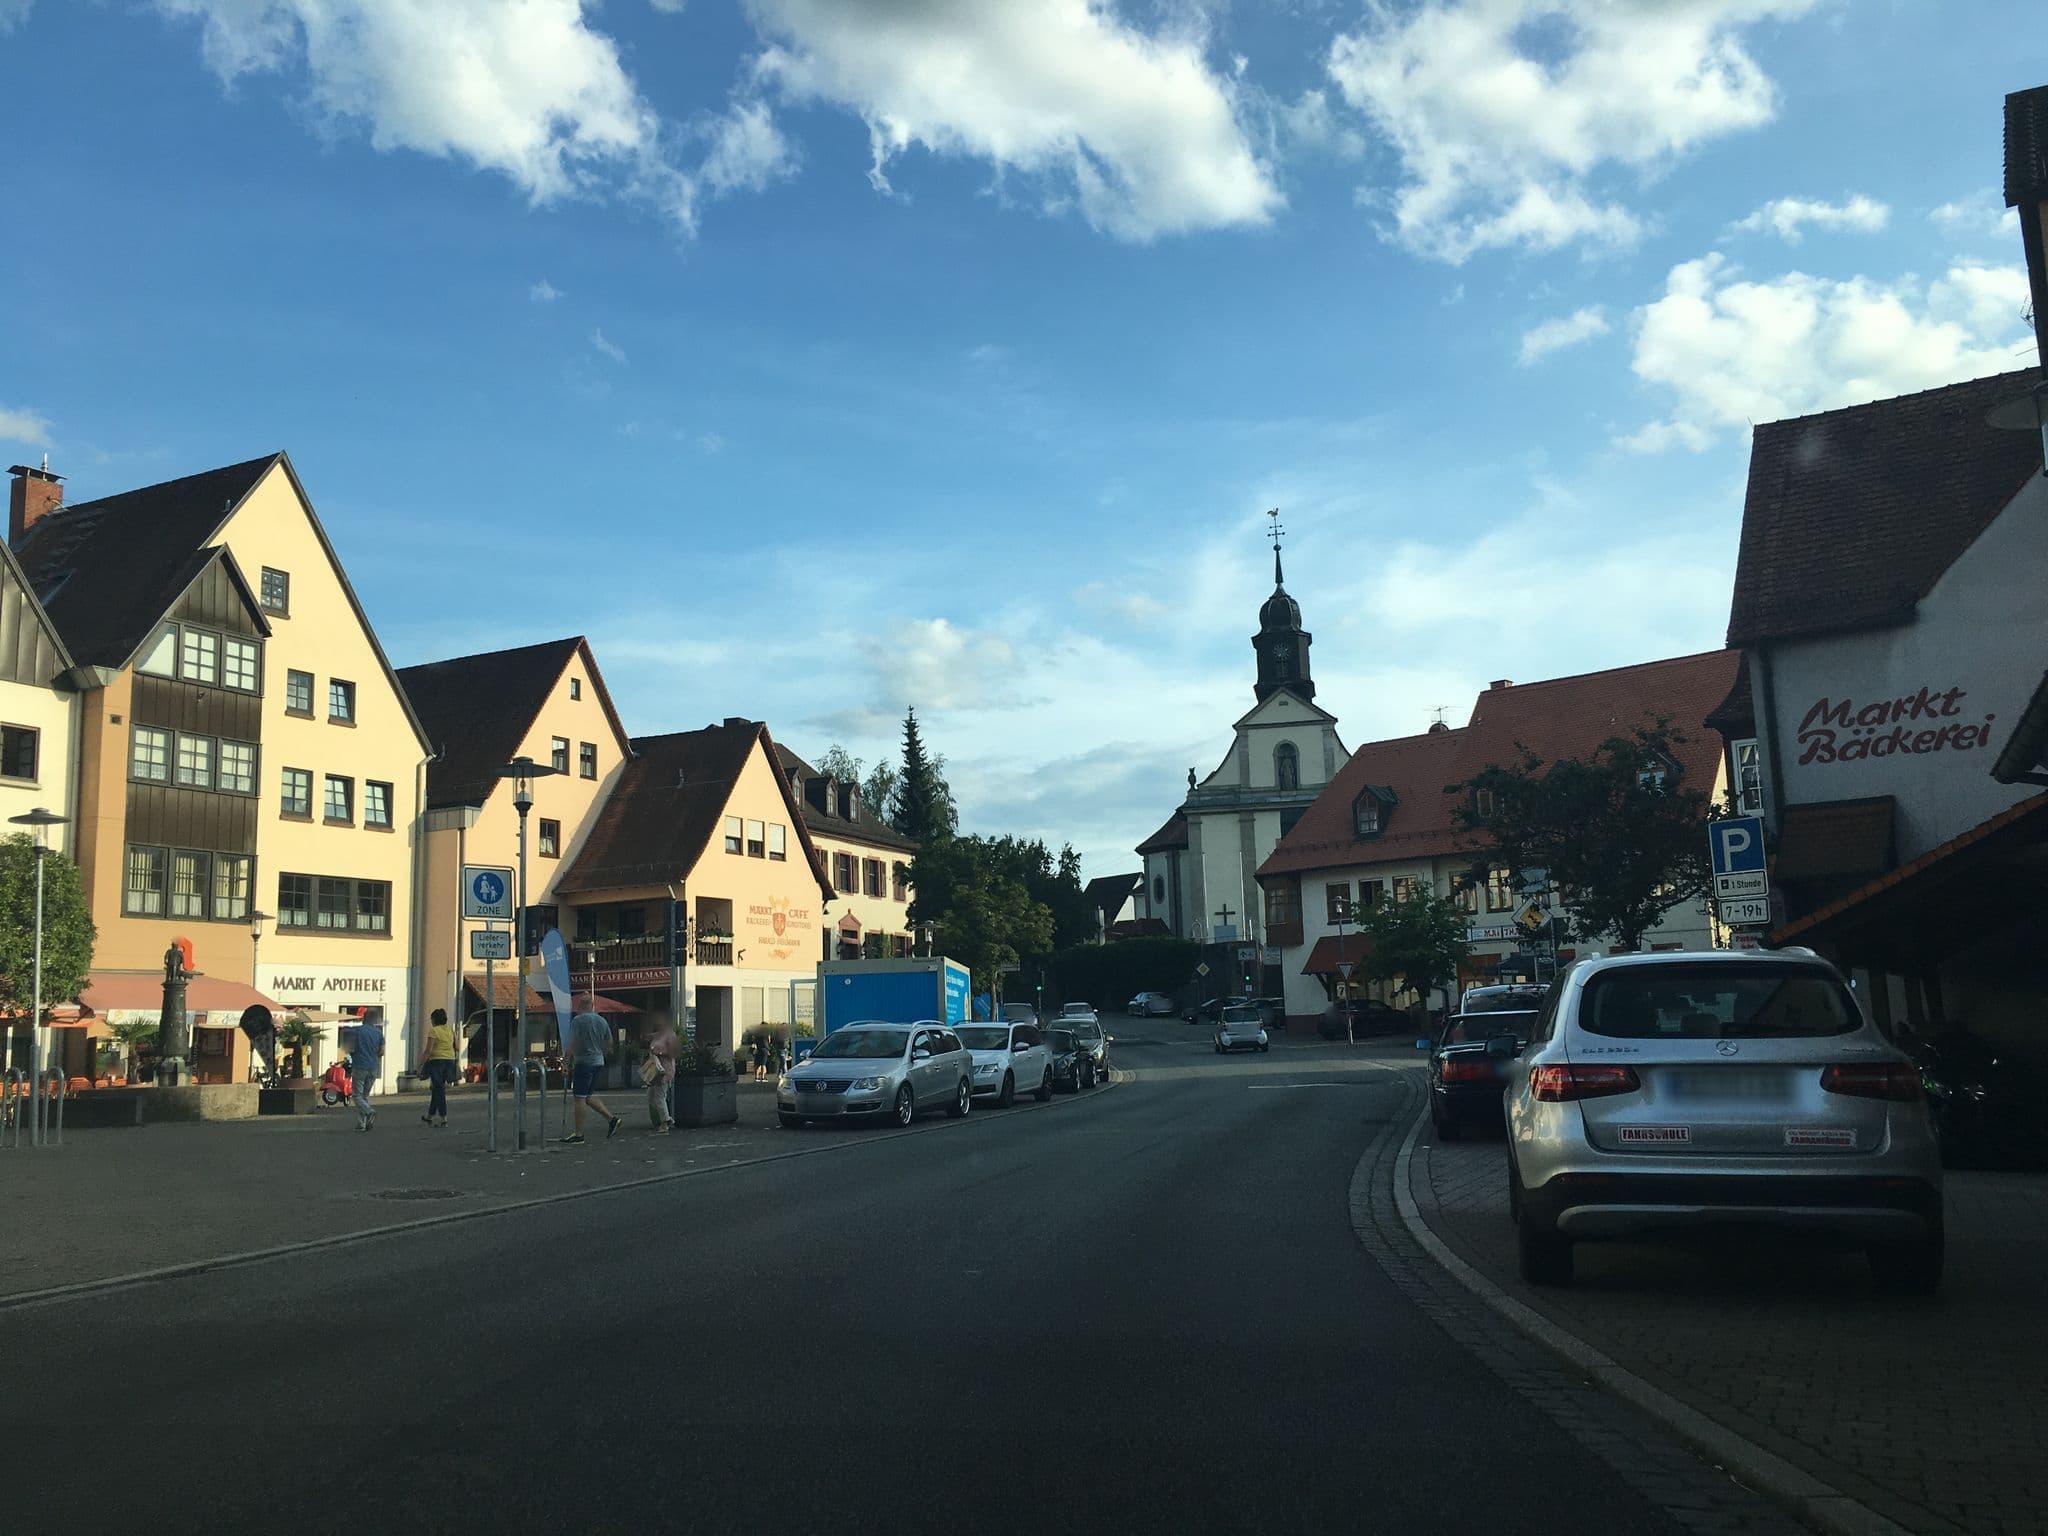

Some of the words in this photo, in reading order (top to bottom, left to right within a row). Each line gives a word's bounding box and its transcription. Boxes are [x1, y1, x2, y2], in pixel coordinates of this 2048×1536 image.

[1797, 686, 1967, 734] Markt
[1797, 713, 1996, 766] Bäckerei
[1721, 827, 1751, 872] P
[1736, 879, 1761, 889] Stunde
[477, 906, 501, 915] ZONE
[478, 933, 504, 942] Liefer-
[477, 942, 505, 950] verkehr
[624, 970, 672, 981] HEILMANN
[272, 976, 316, 991] MARKT
[322, 978, 387, 992] APOTHEKE
